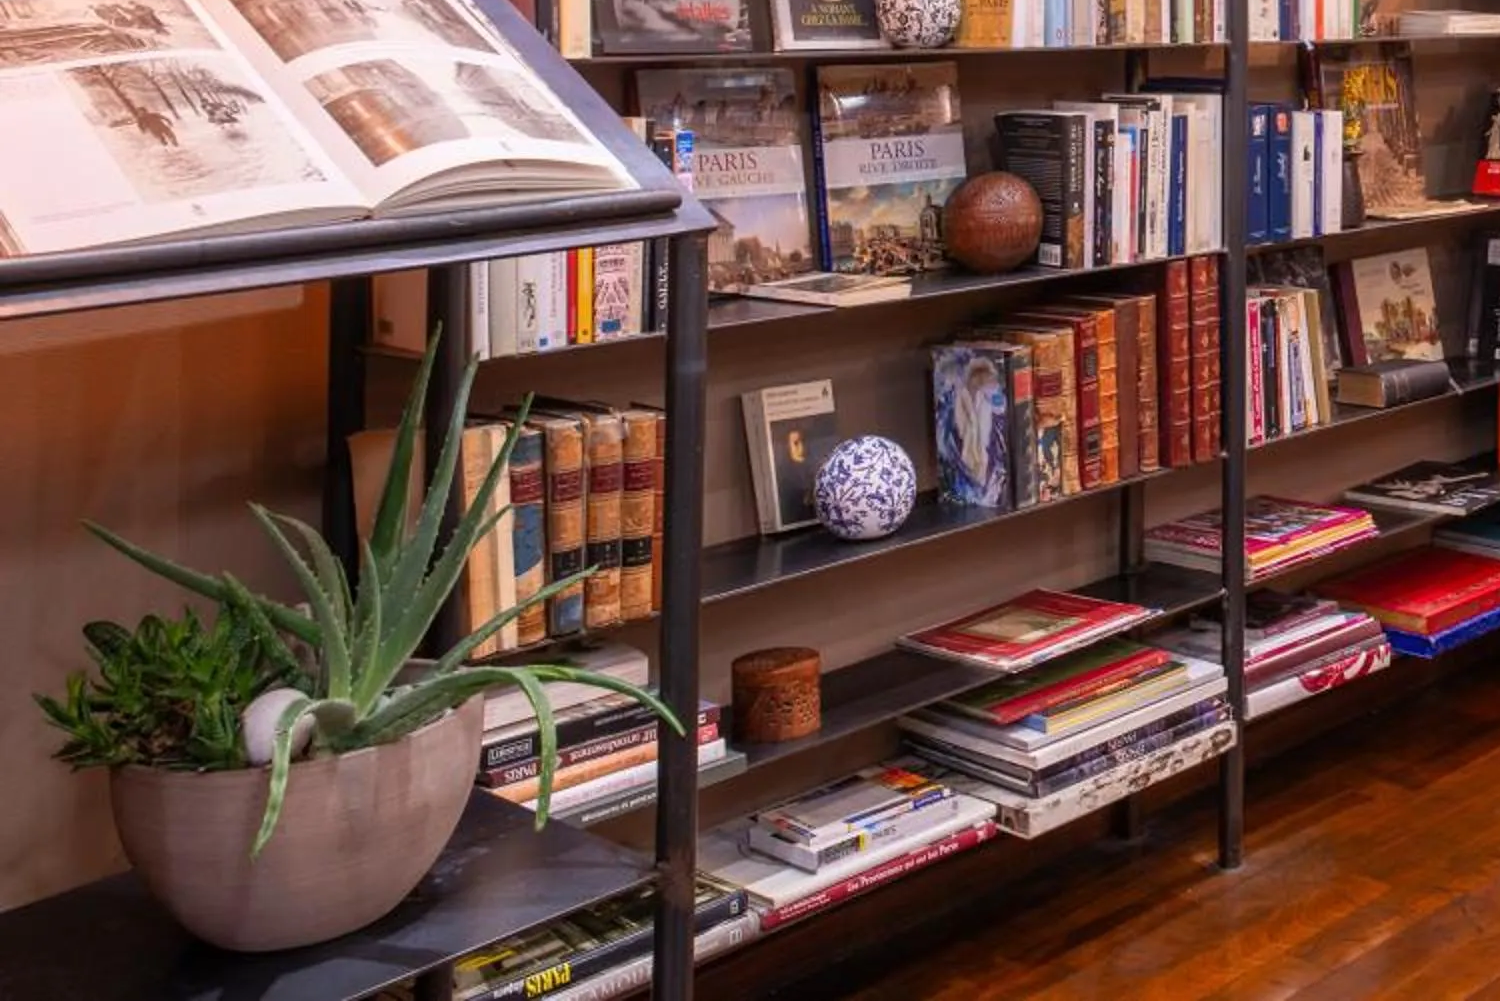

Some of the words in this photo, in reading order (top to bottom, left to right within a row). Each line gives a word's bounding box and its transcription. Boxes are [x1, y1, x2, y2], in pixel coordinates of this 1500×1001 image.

[870, 140, 926, 160] PARIS
[699, 153, 758, 173] PARIS
[523, 961, 572, 998] PARIS
